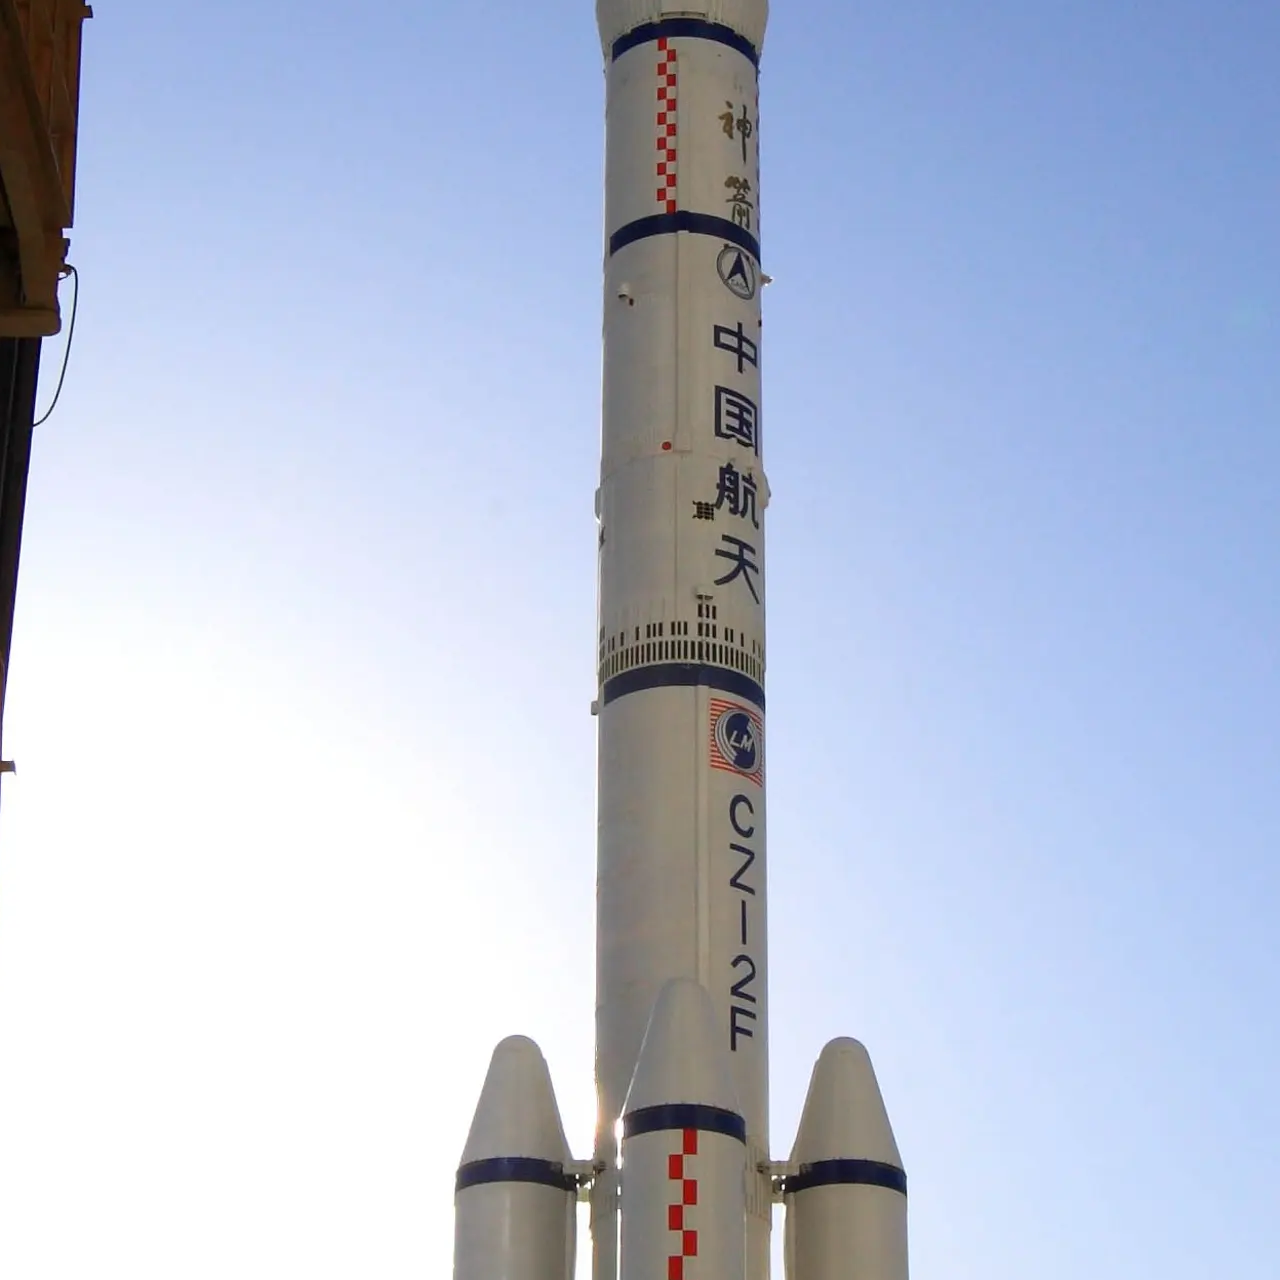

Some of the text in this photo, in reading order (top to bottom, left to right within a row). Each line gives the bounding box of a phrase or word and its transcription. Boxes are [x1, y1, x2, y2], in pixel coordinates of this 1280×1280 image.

[718, 100, 754, 230] 神箭
[713, 322, 759, 605] 中国航天
[730, 730, 754, 752] LM
